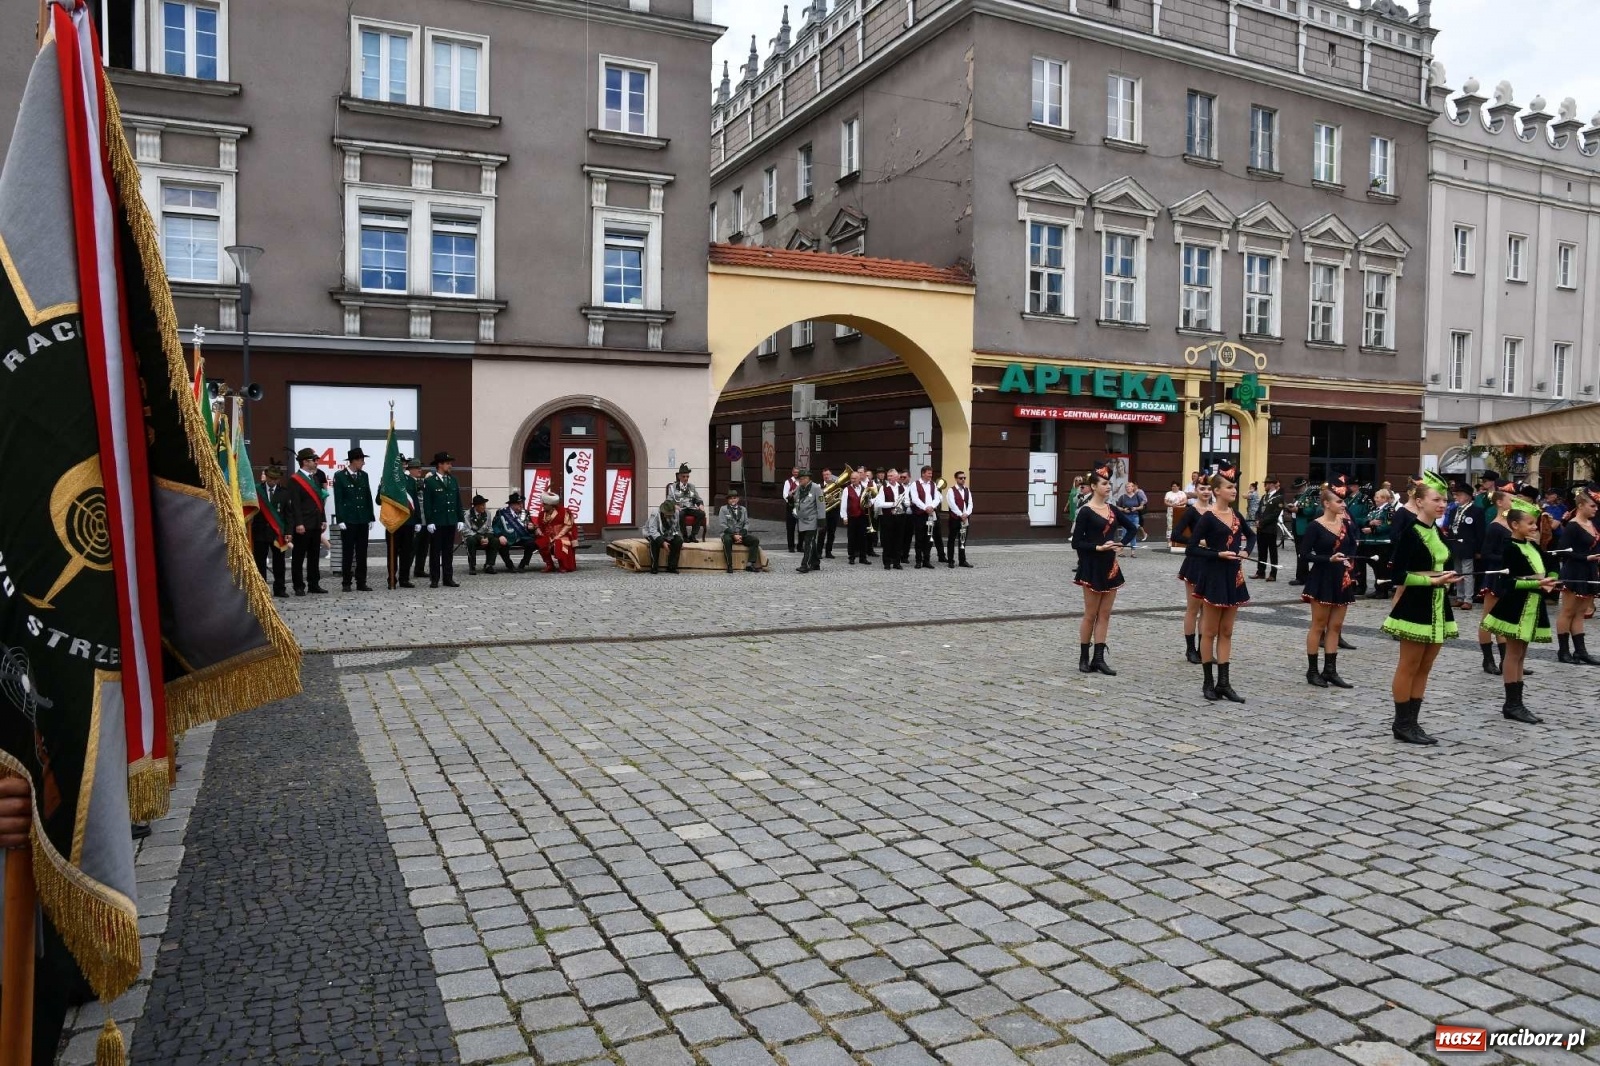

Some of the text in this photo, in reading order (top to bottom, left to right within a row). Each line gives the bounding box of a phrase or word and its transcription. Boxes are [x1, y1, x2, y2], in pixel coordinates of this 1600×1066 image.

[998, 362, 1177, 401] APTEKA
[1020, 408, 1047, 416] RYNEK
[1063, 411, 1099, 419] CENTRUM
[1100, 412, 1163, 422] FARMACEUTYCZNE
[1142, 401, 1176, 411] RÓŻAMI
[576, 451, 591, 474] 432
[571, 474, 587, 496] 716
[609, 475, 631, 516] WYNAJMĘ
